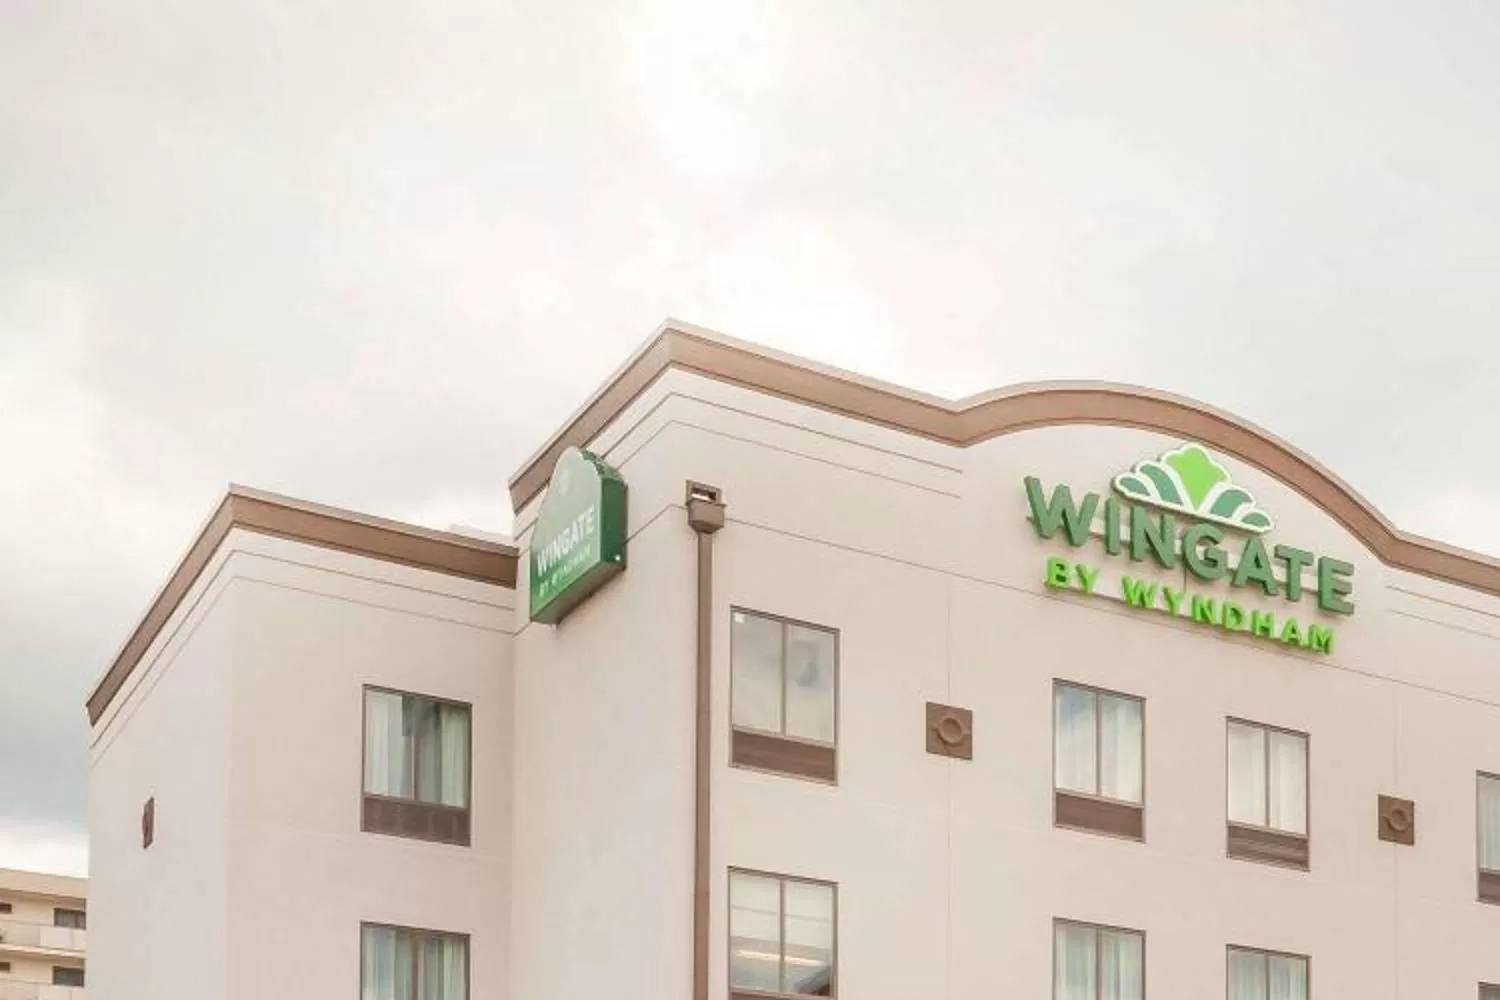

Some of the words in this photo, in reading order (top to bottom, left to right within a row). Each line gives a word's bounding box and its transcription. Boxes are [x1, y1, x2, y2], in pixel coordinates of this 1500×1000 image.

[537, 504, 595, 577] WINGATE
[1024, 475, 1355, 616] WINGATE
[1045, 556, 1099, 595] BY
[1122, 574, 1335, 656] WYNDHAM
